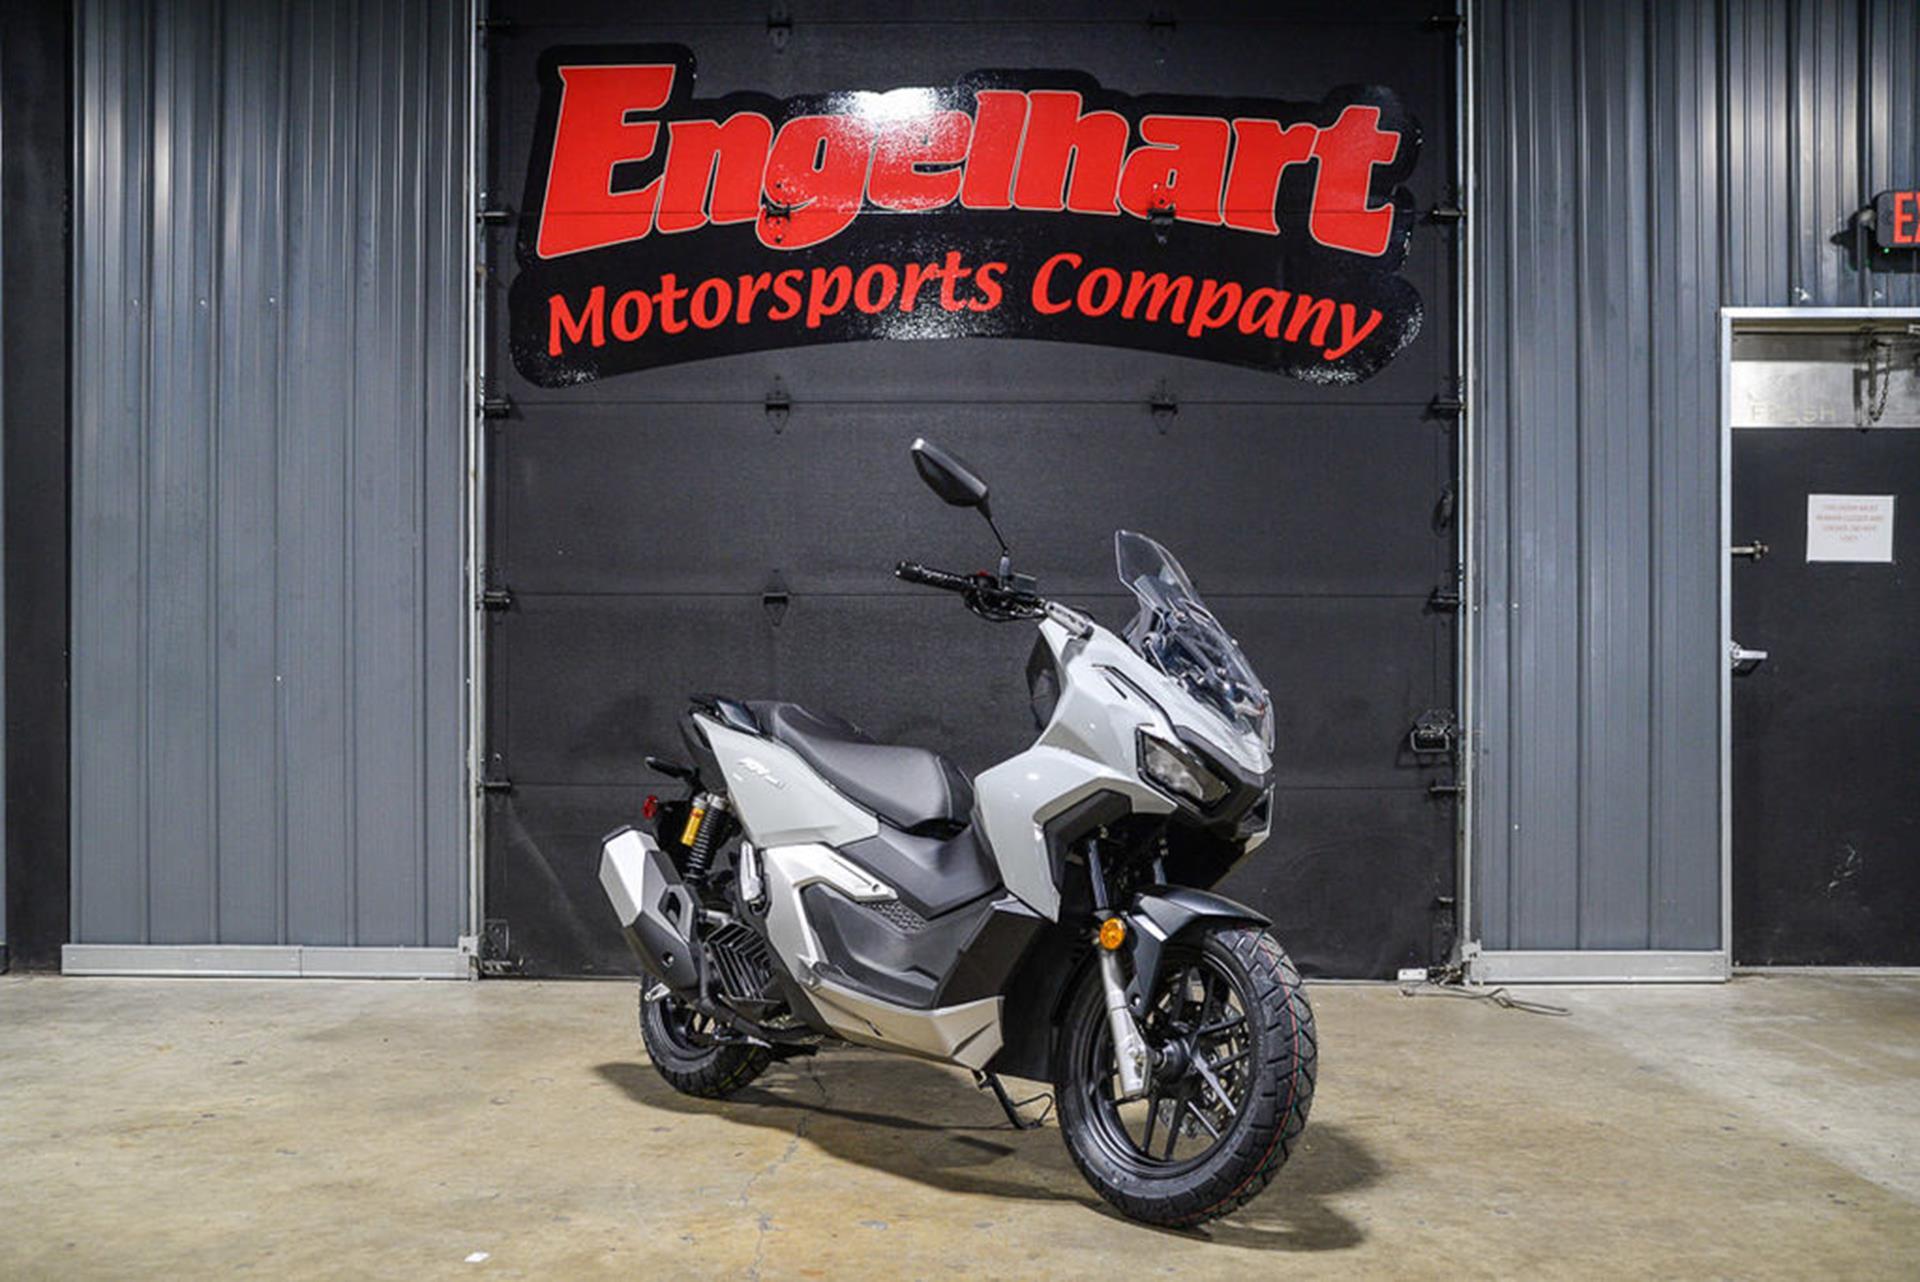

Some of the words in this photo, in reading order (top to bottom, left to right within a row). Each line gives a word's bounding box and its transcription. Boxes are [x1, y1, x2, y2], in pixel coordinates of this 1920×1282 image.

[537, 63, 1400, 257] Engelhart
[548, 250, 1008, 357] Motorsports
[1031, 252, 1383, 361] Company
